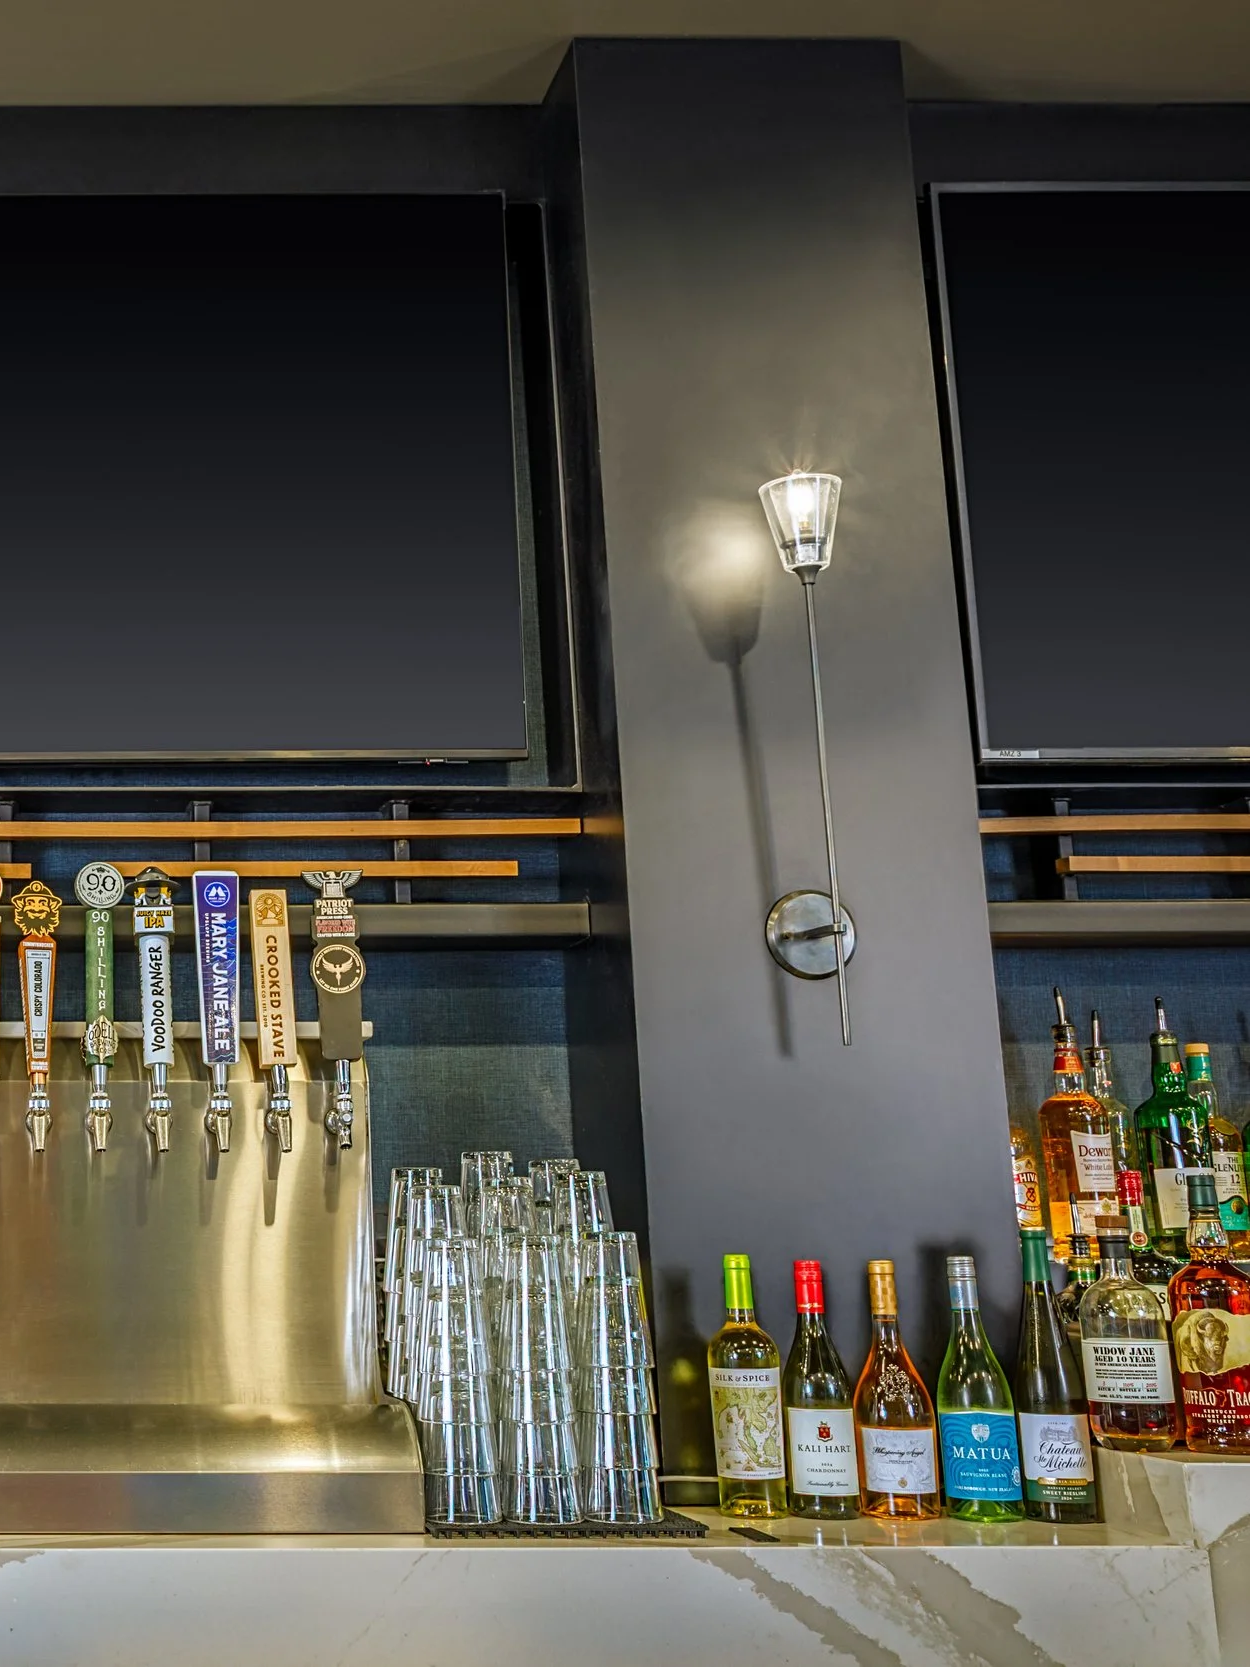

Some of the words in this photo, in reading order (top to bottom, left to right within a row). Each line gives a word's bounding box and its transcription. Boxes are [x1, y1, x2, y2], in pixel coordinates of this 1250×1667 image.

[86, 873, 116, 892] 90
[316, 899, 352, 908] PATRIOT
[92, 911, 110, 922] 90
[144, 916, 164, 928] IPA
[211, 912, 228, 960] MARY
[34, 960, 42, 993] COLORADO
[97, 926, 106, 1012] SHILLING
[148, 945, 164, 996] RANGER
[266, 935, 281, 1009] CROOKED
[212, 962, 230, 1011] JANE
[34, 995, 42, 1016] CRISPY
[151, 1000, 166, 1052] VOODOO
[214, 1015, 230, 1050] ALE
[271, 1014, 285, 1058] STAVE
[1230, 1174, 1240, 1184] 12
[1093, 1346, 1126, 1355] WIDOW
[1130, 1347, 1155, 1355] JANE
[1227, 1389, 1250, 1407] TRA
[798, 1444, 821, 1452] KALI
[953, 1446, 1011, 1460] MATUA
[1039, 1440, 1082, 1455] Chateau
[1034, 1454, 1046, 1463] Ste
[1039, 1455, 1087, 1471] Michelle
